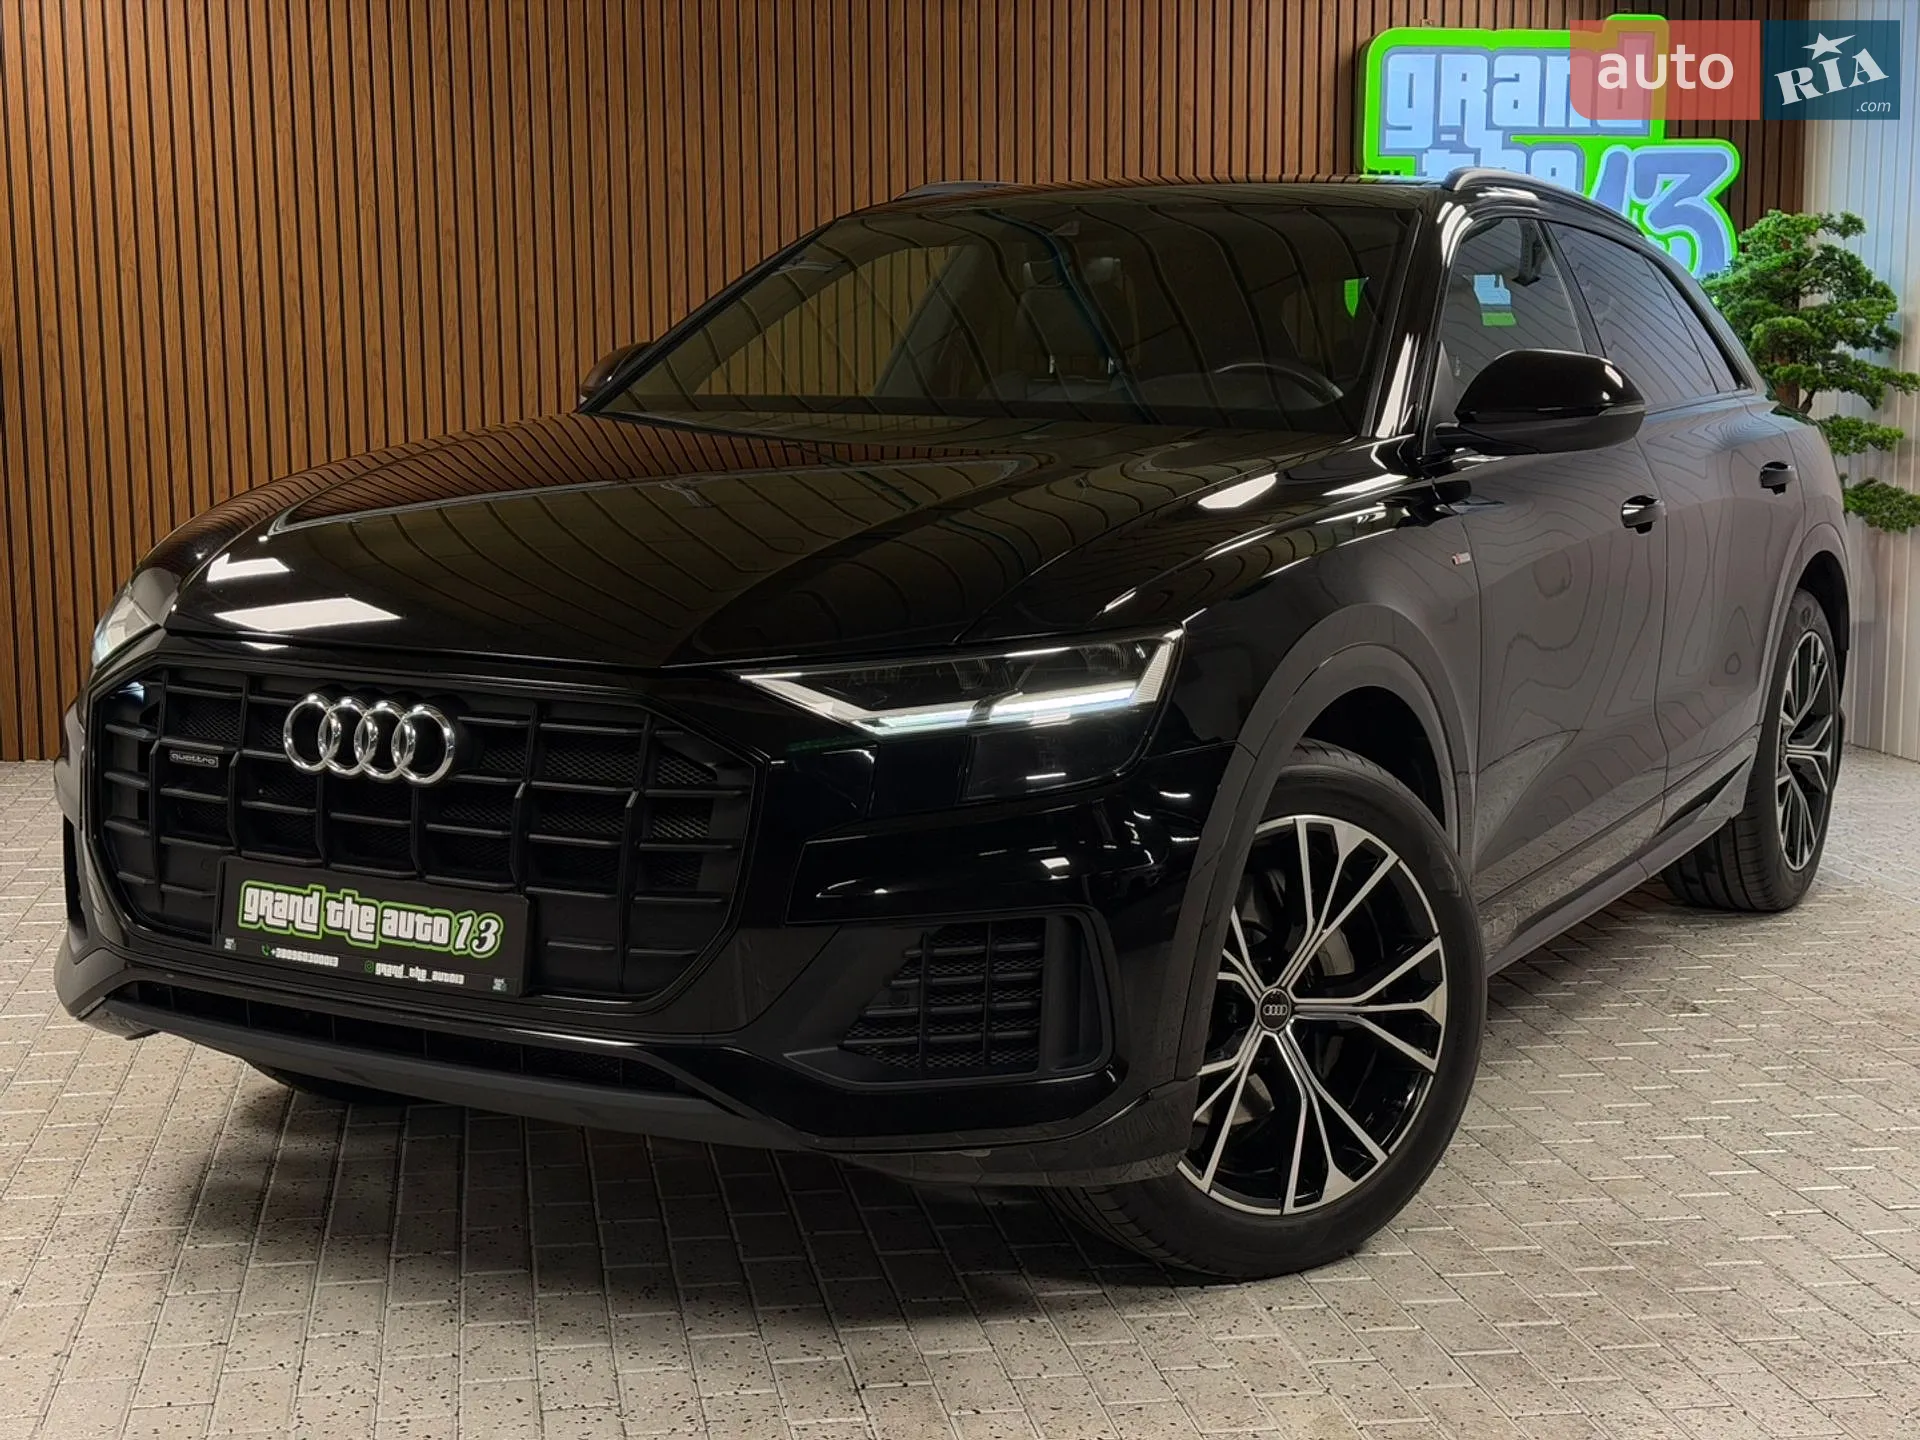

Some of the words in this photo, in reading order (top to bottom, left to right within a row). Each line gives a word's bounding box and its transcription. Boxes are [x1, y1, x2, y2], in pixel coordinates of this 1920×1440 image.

[326, 896, 376, 941] the
[382, 909, 450, 944] auto
[455, 916, 499, 953] 13
